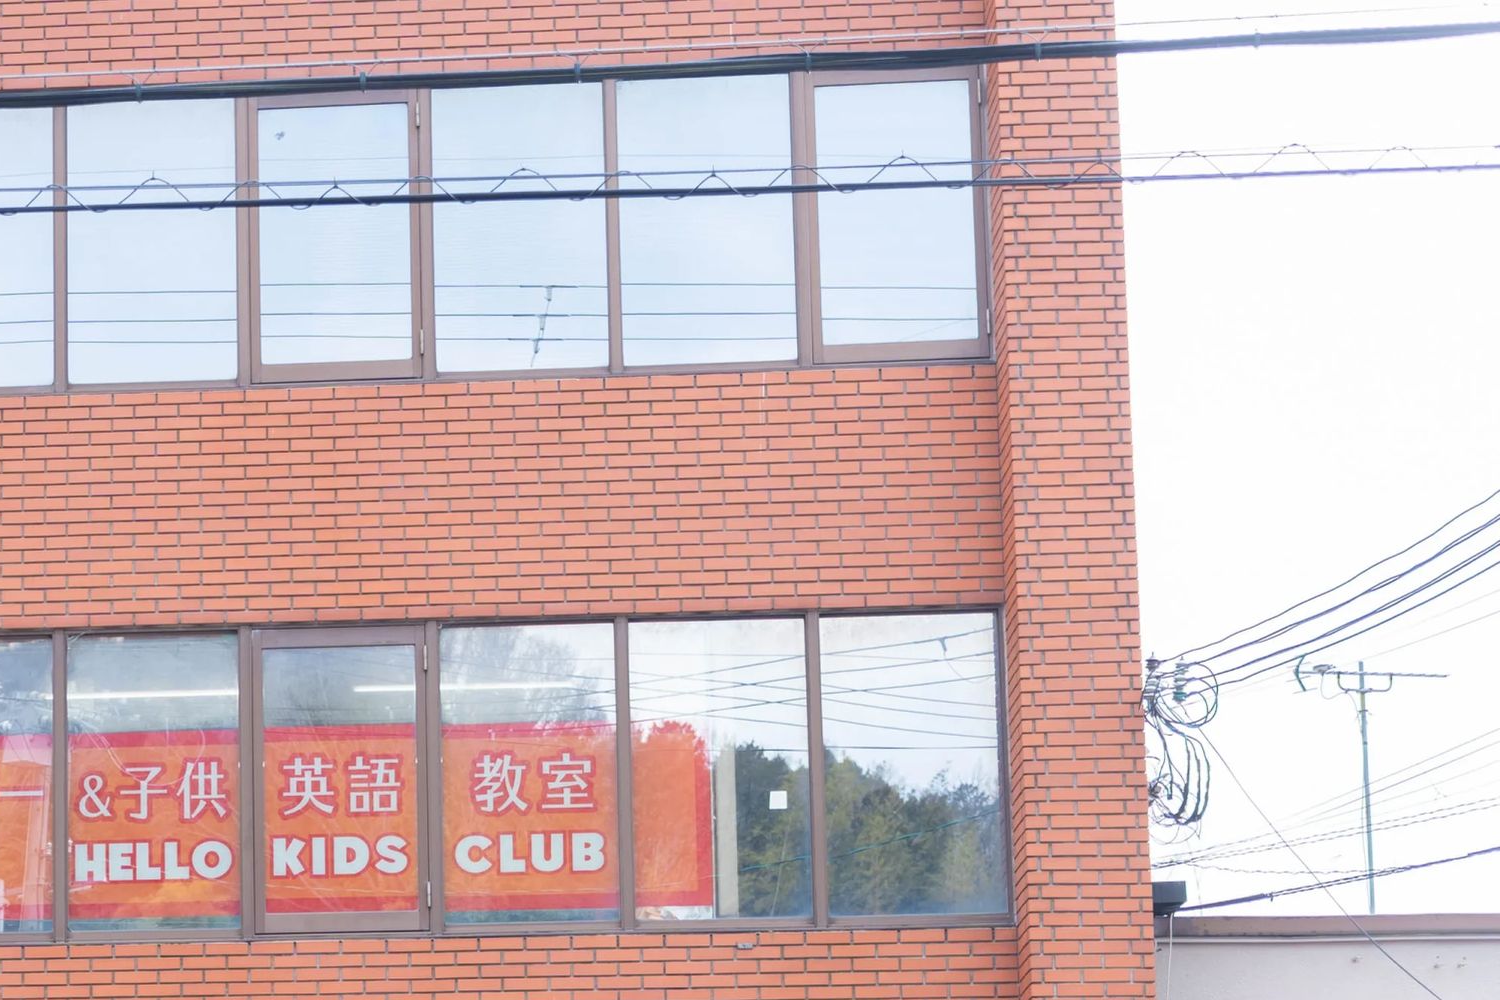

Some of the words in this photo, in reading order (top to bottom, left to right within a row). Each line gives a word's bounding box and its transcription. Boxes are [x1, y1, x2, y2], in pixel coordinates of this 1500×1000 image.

[282, 756, 401, 815] 英語
[474, 752, 594, 813] 教室
[74, 840, 233, 882] HELLO
[272, 835, 408, 876] KIDS
[454, 832, 605, 874] CLUB
